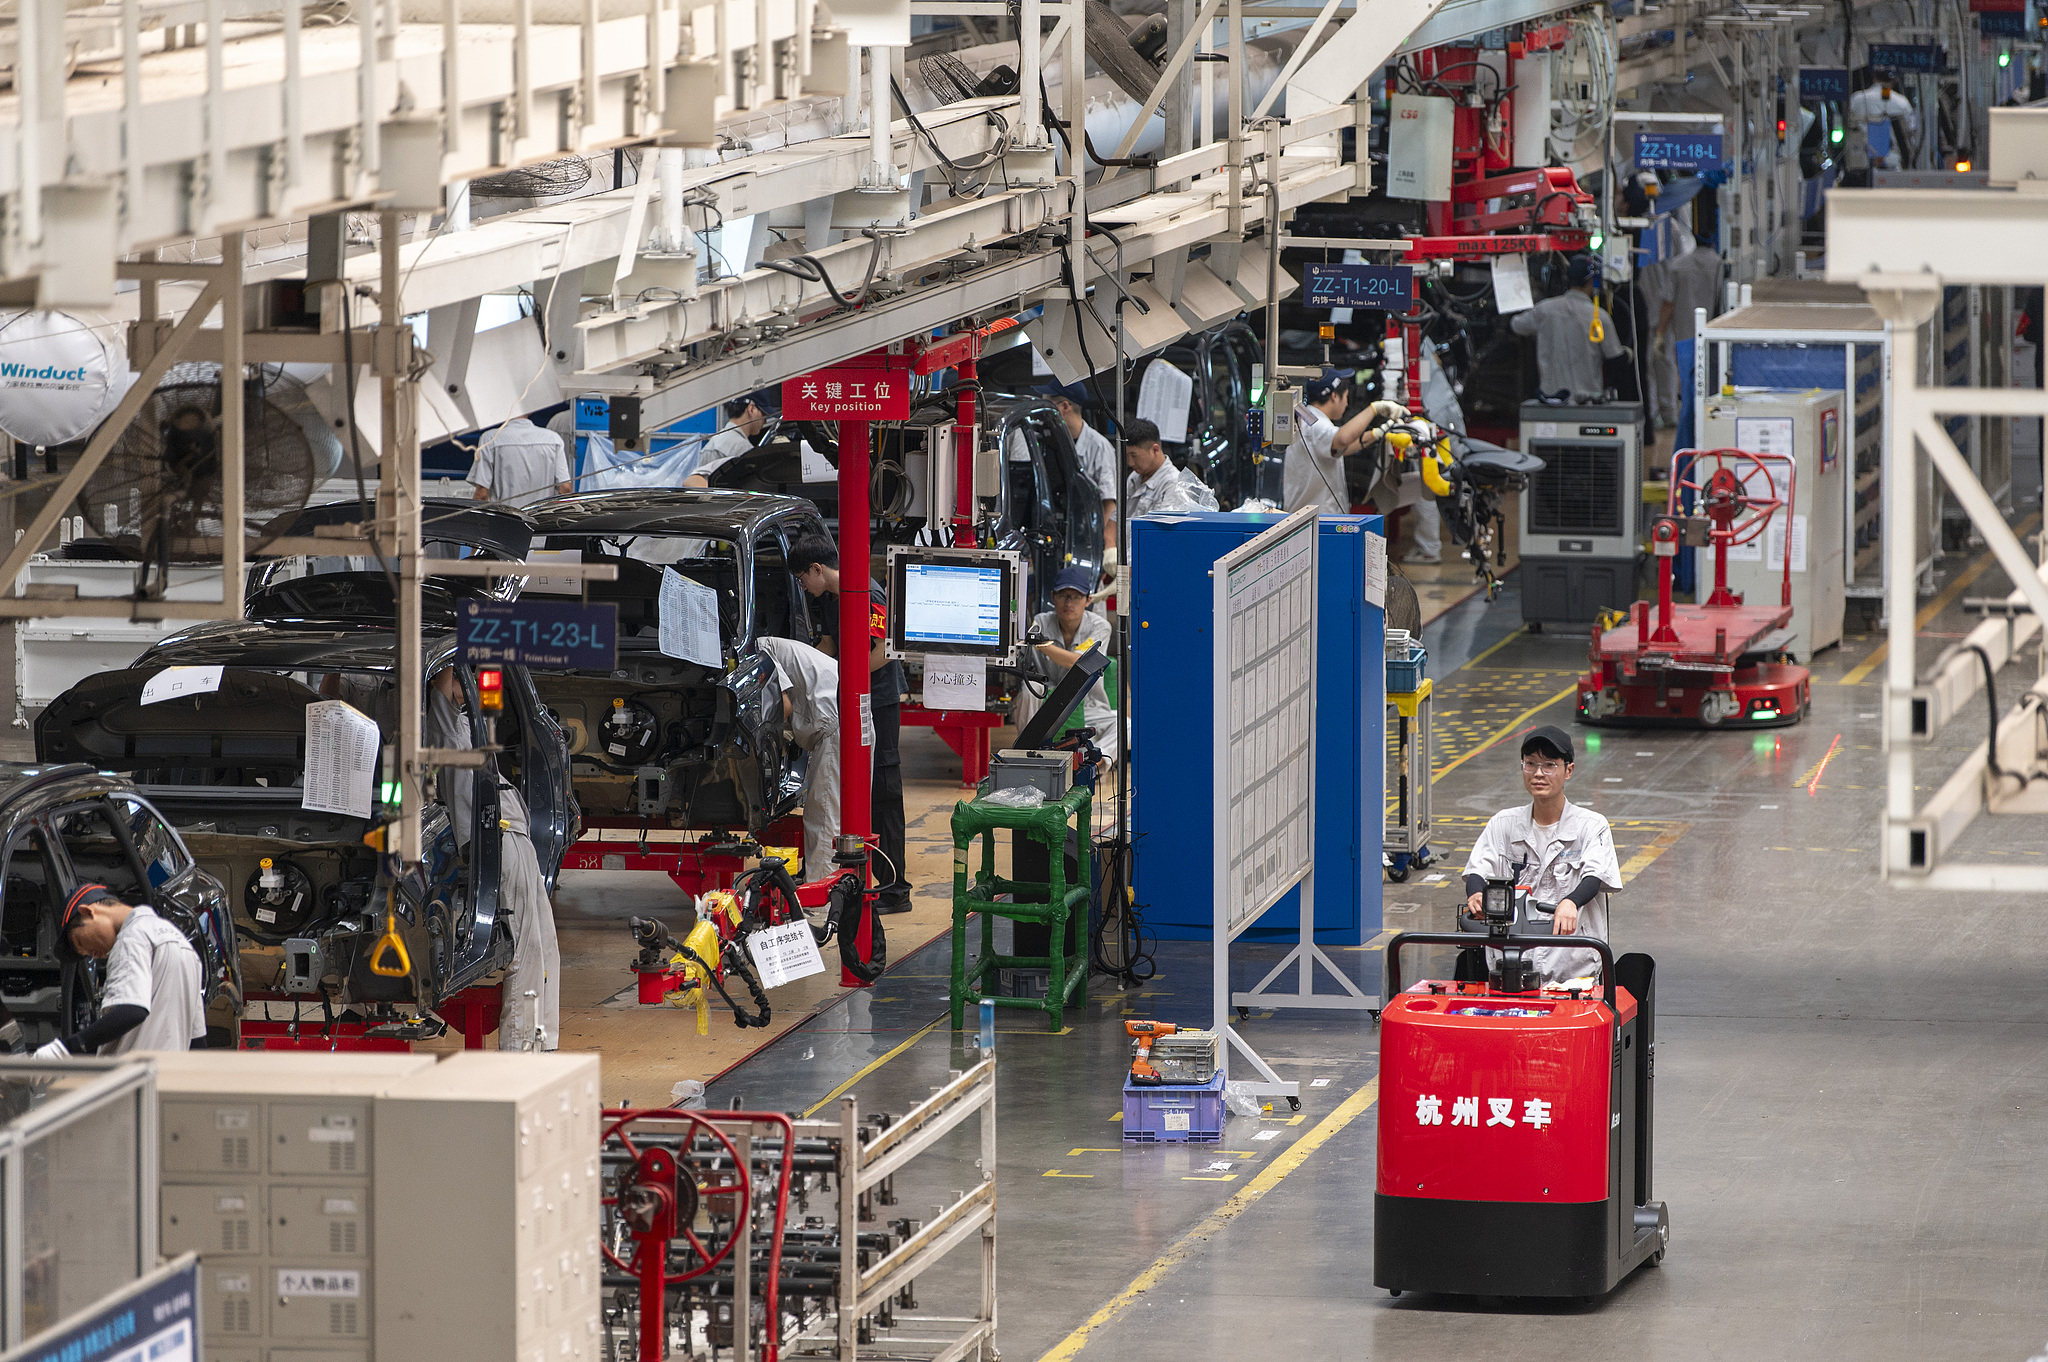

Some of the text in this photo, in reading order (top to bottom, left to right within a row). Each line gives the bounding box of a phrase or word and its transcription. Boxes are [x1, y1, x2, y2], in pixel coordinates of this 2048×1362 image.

[1640, 142, 1717, 159] ZZ-T1-18-L
[1458, 238, 1537, 253] max 125Kg
[1312, 276, 1405, 295] ZZ-T1-20-L
[1312, 296, 1345, 305] 内饰一线
[0, 362, 87, 381] Winduct
[801, 382, 891, 399] 关键工位
[810, 402, 882, 413] Key position
[870, 613, 885, 629] 员工
[468, 618, 605, 648] ZZ-T1-23-L
[467, 646, 516, 662] 内饰一线
[524, 653, 543, 662] Trim
[544, 654, 562, 664] Line
[929, 672, 977, 686] 小心撞头
[759, 930, 805, 951] 自工序完结卡
[1415, 1094, 1552, 1130] 杭州叉车
